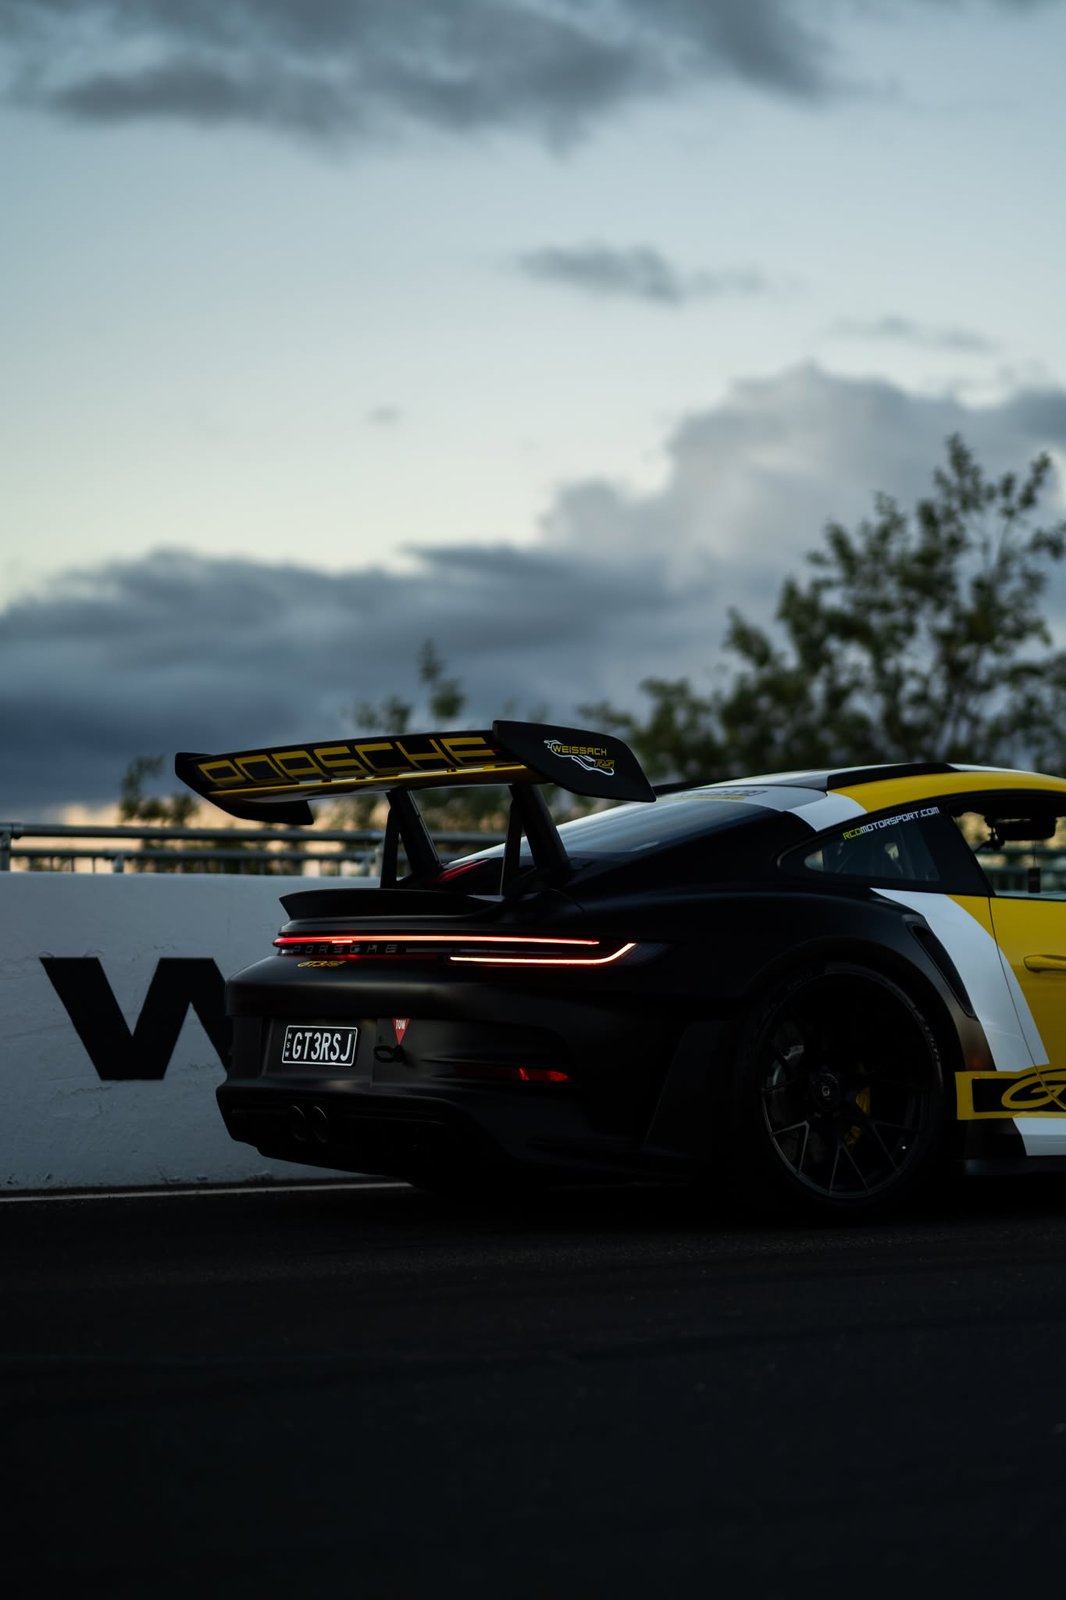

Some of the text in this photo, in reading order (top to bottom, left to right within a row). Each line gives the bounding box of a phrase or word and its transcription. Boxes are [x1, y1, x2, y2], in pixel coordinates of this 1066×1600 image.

[198, 736, 498, 785] PORSCHE
[552, 744, 608, 757] WEISSACH
[291, 943, 400, 954] PORSCHE
[292, 1032, 352, 1061] GT3RSJ
